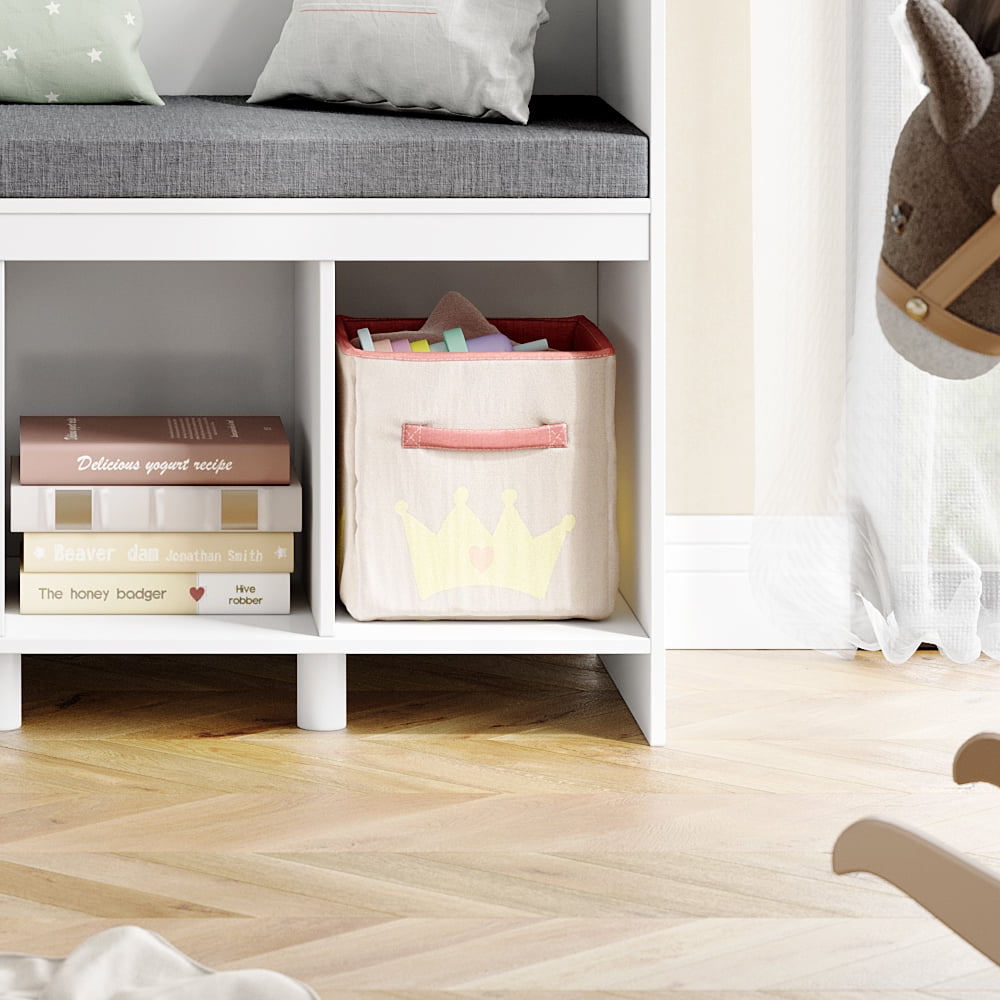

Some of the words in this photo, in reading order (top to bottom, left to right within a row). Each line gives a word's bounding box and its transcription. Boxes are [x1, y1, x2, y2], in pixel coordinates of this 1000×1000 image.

[76, 455, 140, 472] Delicious
[145, 458, 189, 475] yogurt
[193, 458, 233, 474] recipe
[54, 544, 116, 561] Beaver
[128, 544, 159, 561] dam
[166, 549, 222, 562] Jonathan
[228, 549, 263, 562] Smith
[39, 588, 63, 600] The
[70, 588, 109, 601] honey
[116, 588, 167, 601] badger
[236, 584, 256, 594] Hive
[229, 596, 263, 605] robber
